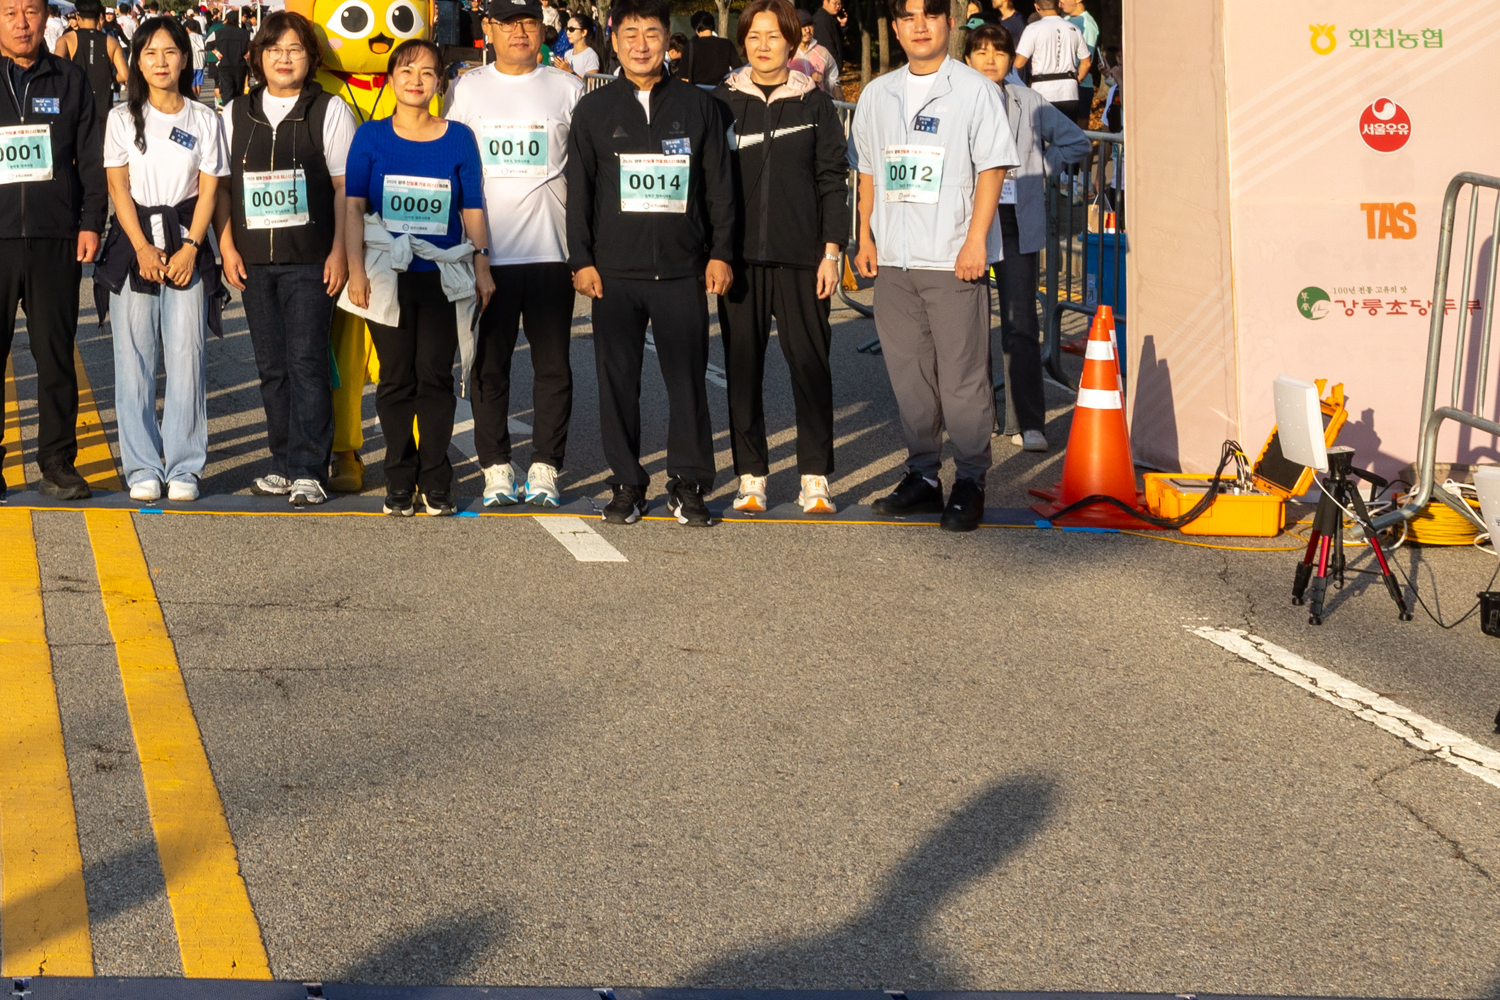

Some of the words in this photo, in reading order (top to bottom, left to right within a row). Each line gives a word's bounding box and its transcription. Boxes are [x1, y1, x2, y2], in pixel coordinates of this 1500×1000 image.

[1348, 28, 1444, 49] 회천농협
[1362, 122, 1409, 136] 서울우유
[489, 140, 540, 156] 0010
[629, 174, 680, 190] 0014
[890, 165, 933, 182] 0012
[252, 189, 299, 207] 0005
[390, 195, 442, 214] 0009
[1360, 202, 1417, 240] TAS
[1333, 286, 1356, 295] 100년
